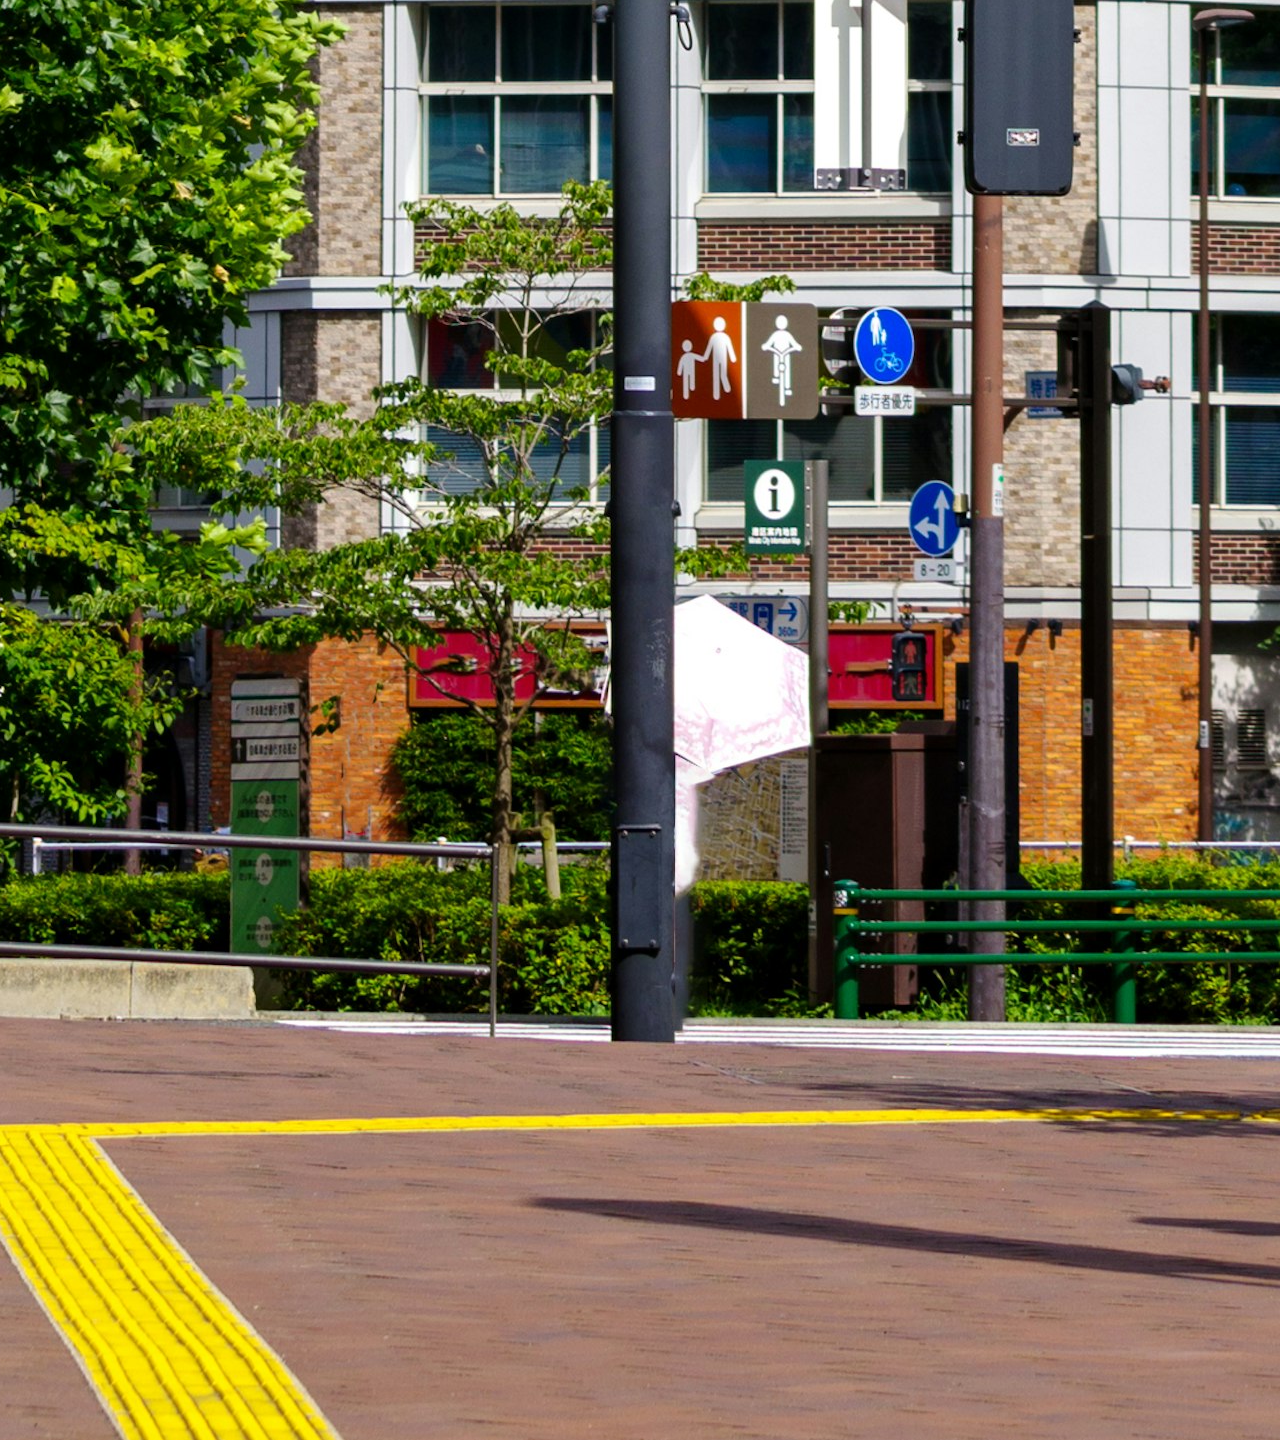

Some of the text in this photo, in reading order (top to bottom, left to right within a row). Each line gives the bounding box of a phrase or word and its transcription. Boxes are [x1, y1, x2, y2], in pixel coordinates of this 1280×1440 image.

[859, 393, 913, 410] 歩行者優先
